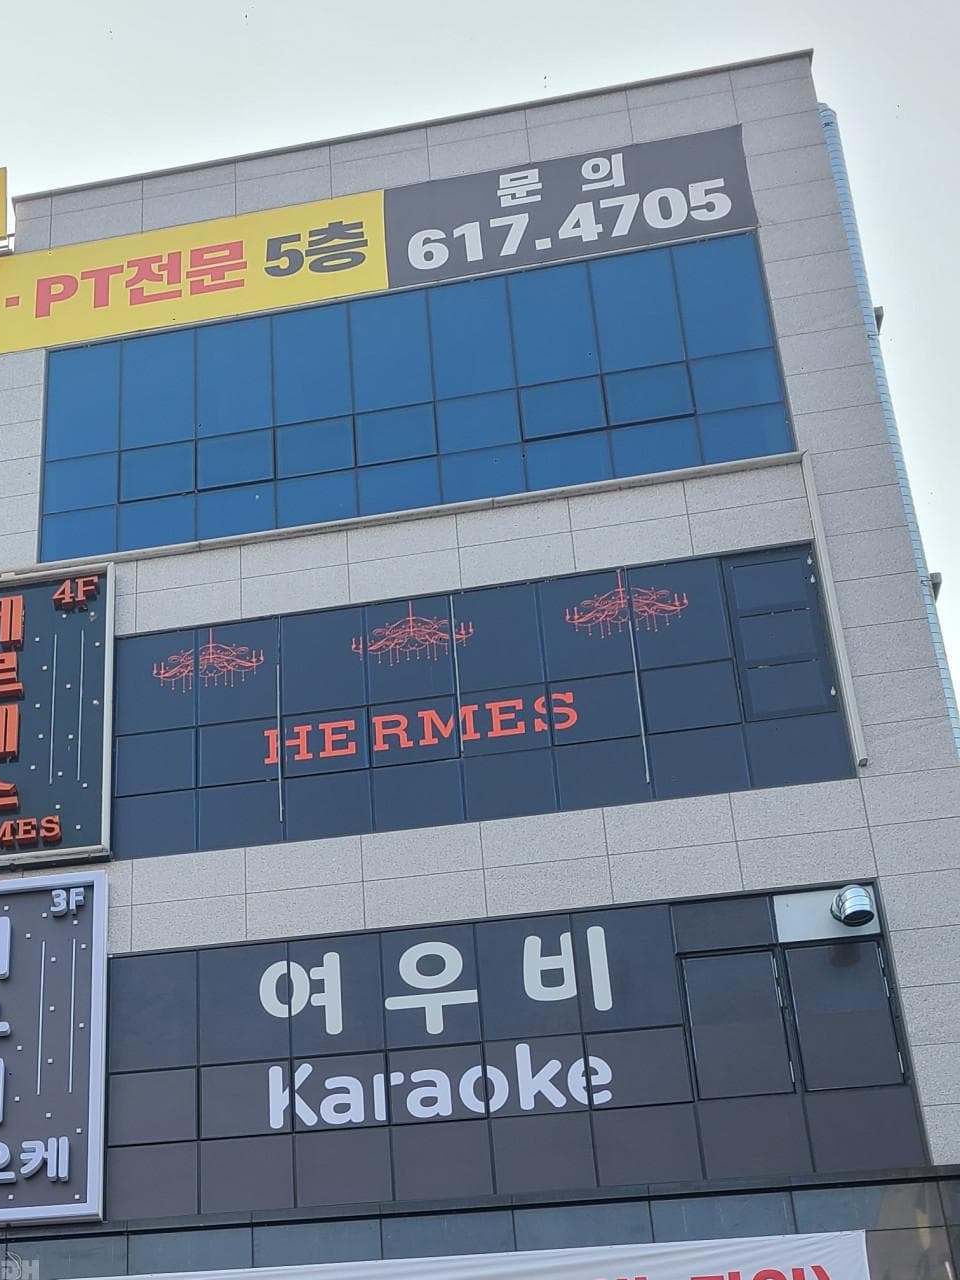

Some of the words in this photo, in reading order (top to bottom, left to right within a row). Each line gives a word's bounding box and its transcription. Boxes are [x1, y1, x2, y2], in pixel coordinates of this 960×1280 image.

[407, 177, 733, 271] 617.4705
[35, 239, 248, 319] PT전문
[265, 220, 369, 279] 5층
[52, 576, 99, 608] 4F
[264, 692, 578, 765] HERMES
[50, 887, 85, 916] 3F
[259, 926, 613, 1036] 여우비
[269, 1043, 613, 1129] Karaoke
